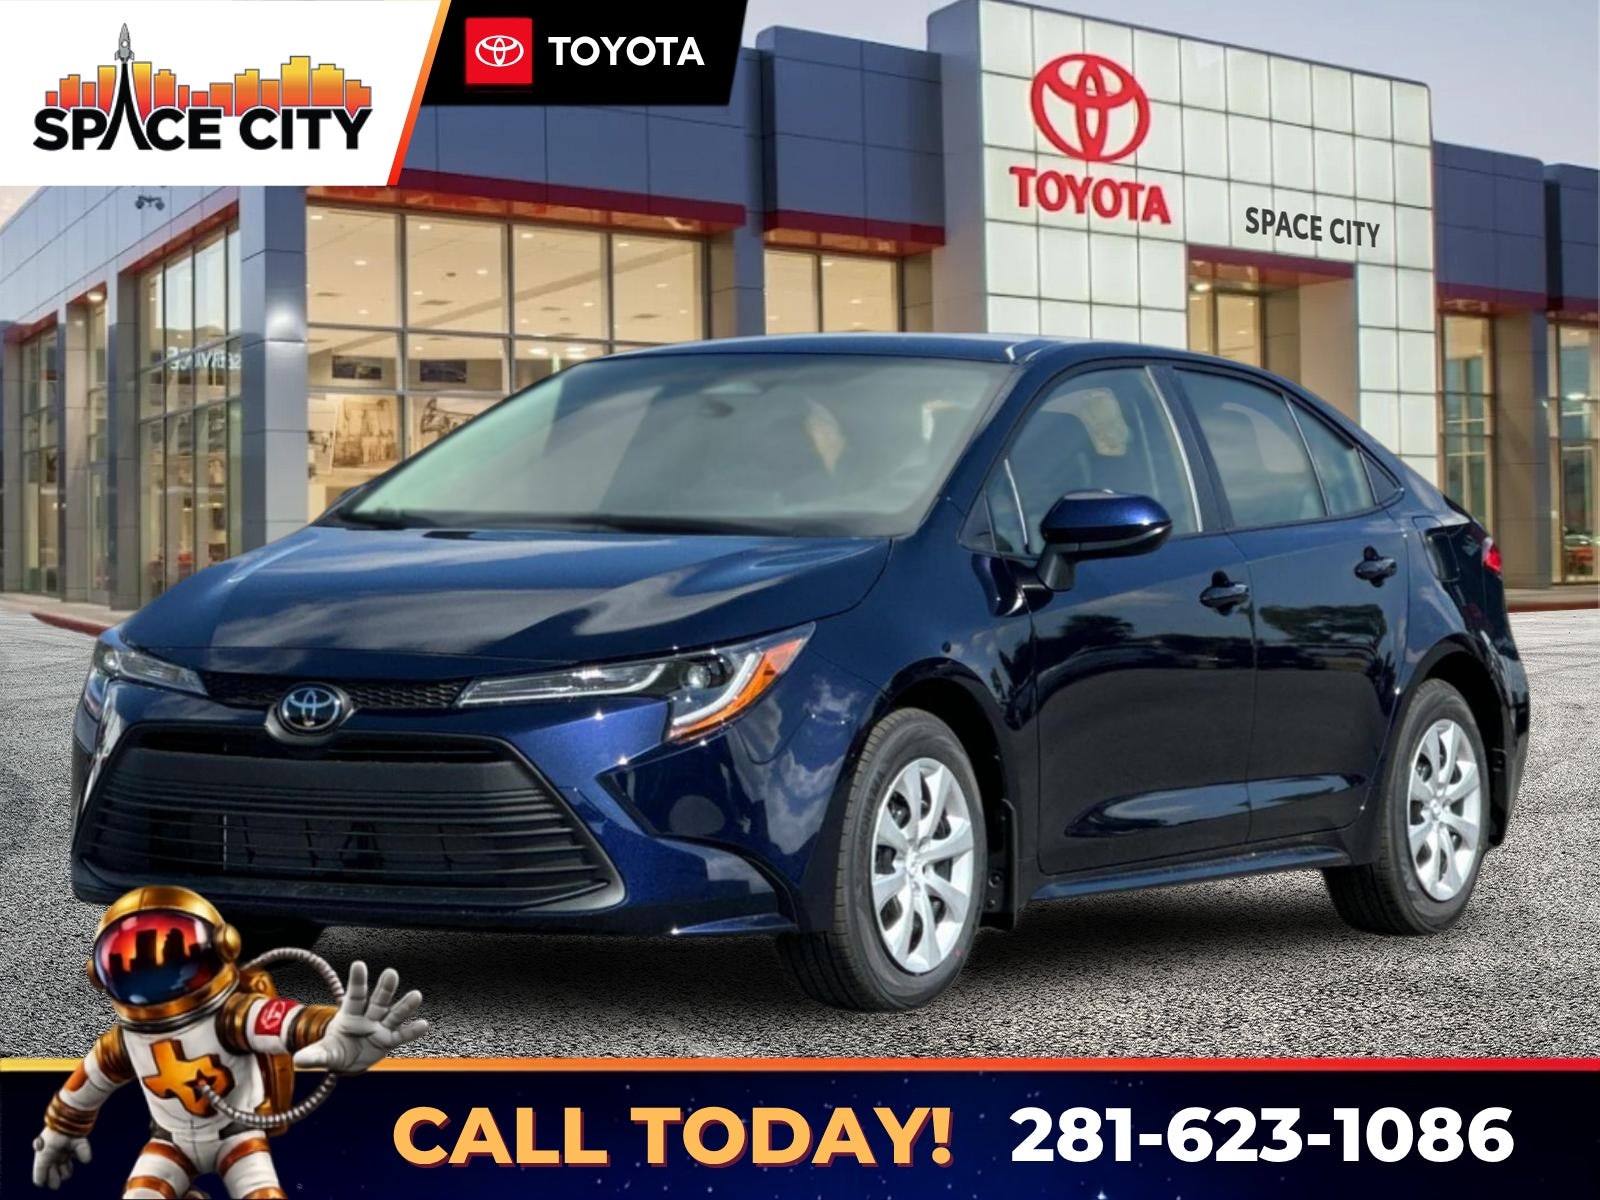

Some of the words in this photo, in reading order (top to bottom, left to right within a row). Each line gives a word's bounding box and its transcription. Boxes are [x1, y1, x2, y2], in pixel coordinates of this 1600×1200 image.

[1009, 166, 1171, 225] TOYOTA
[1246, 206, 1322, 242] SPACE
[1330, 217, 1380, 248] CITY
